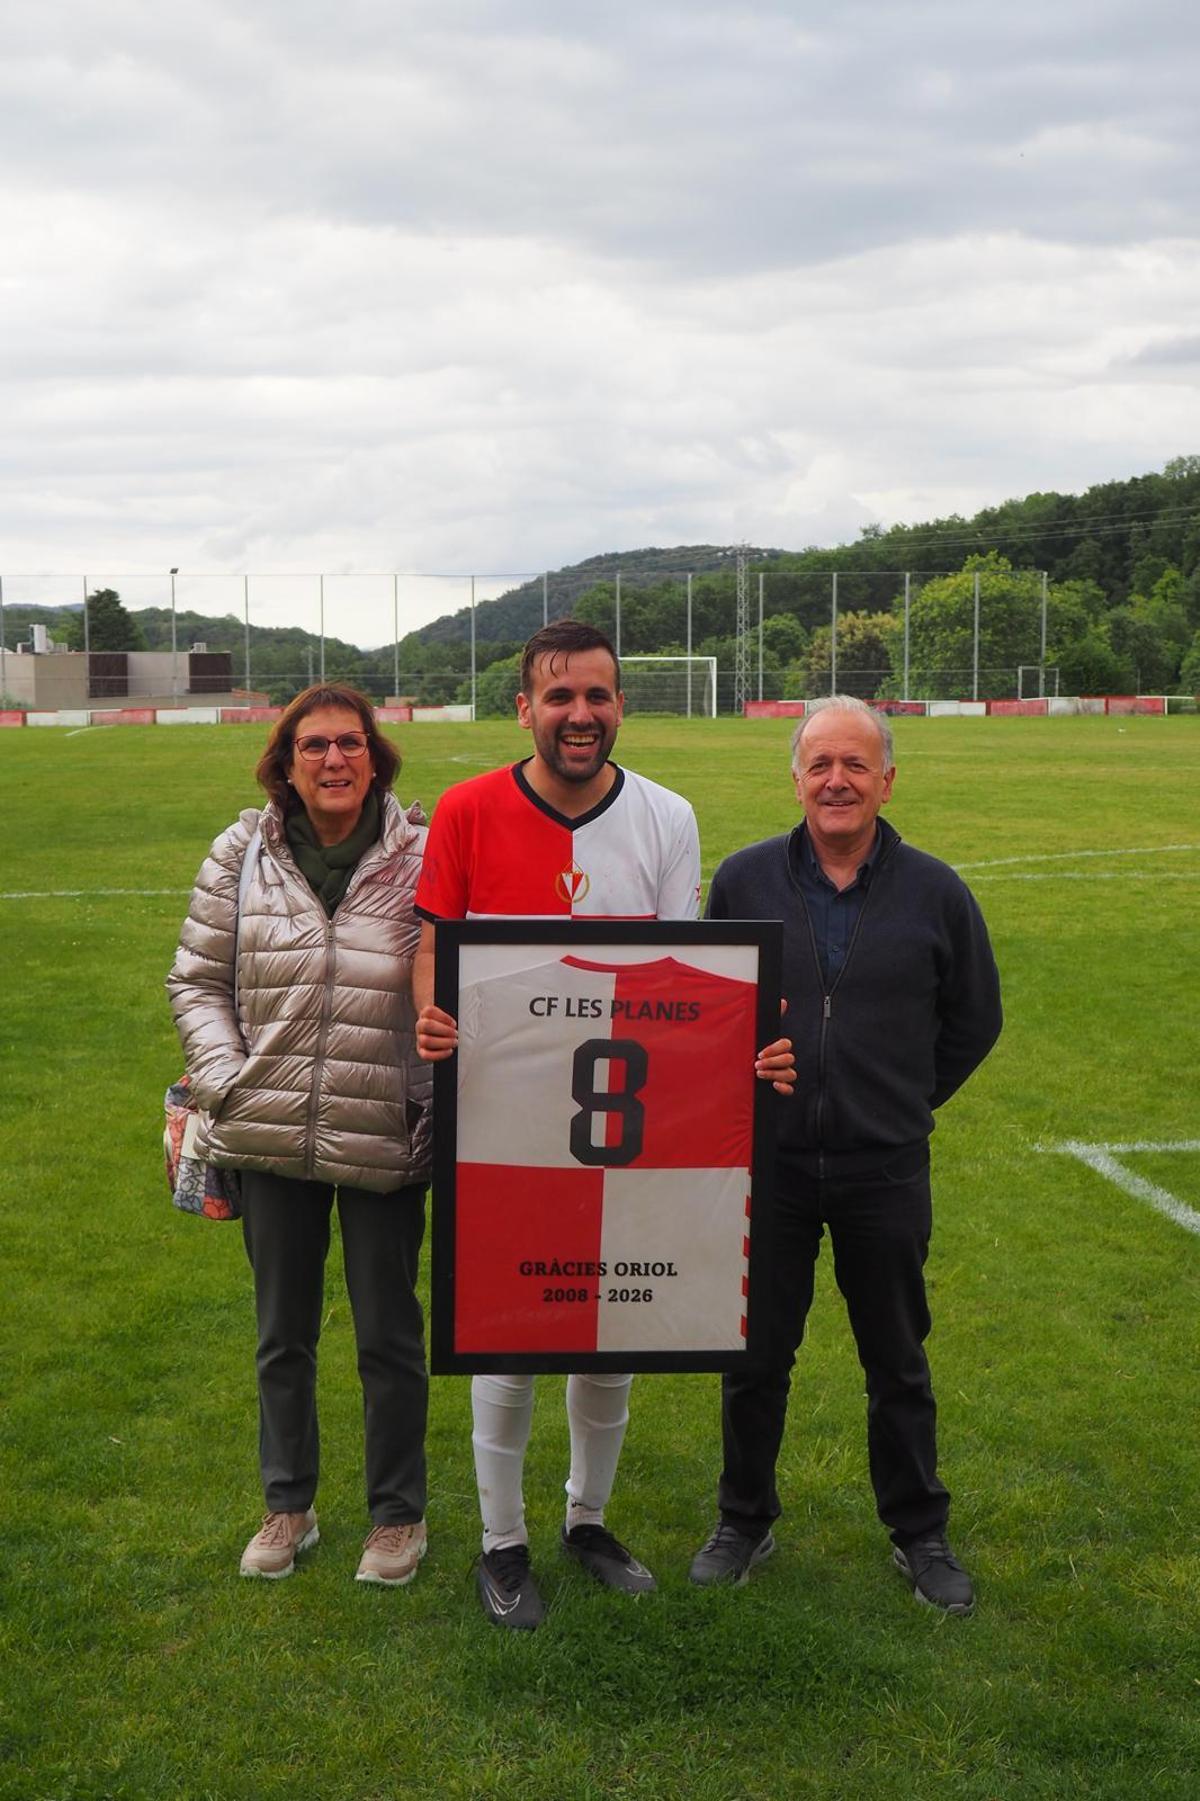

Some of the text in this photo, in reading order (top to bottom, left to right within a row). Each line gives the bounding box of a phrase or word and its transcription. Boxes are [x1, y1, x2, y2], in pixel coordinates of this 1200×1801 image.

[529, 997, 701, 1022] CF LES PLANES
[569, 1038, 649, 1166] 8
[519, 1258, 678, 1277] GRÀCIES ORIOL
[543, 1288, 588, 1303] 2008
[607, 1288, 653, 1303] 2026
